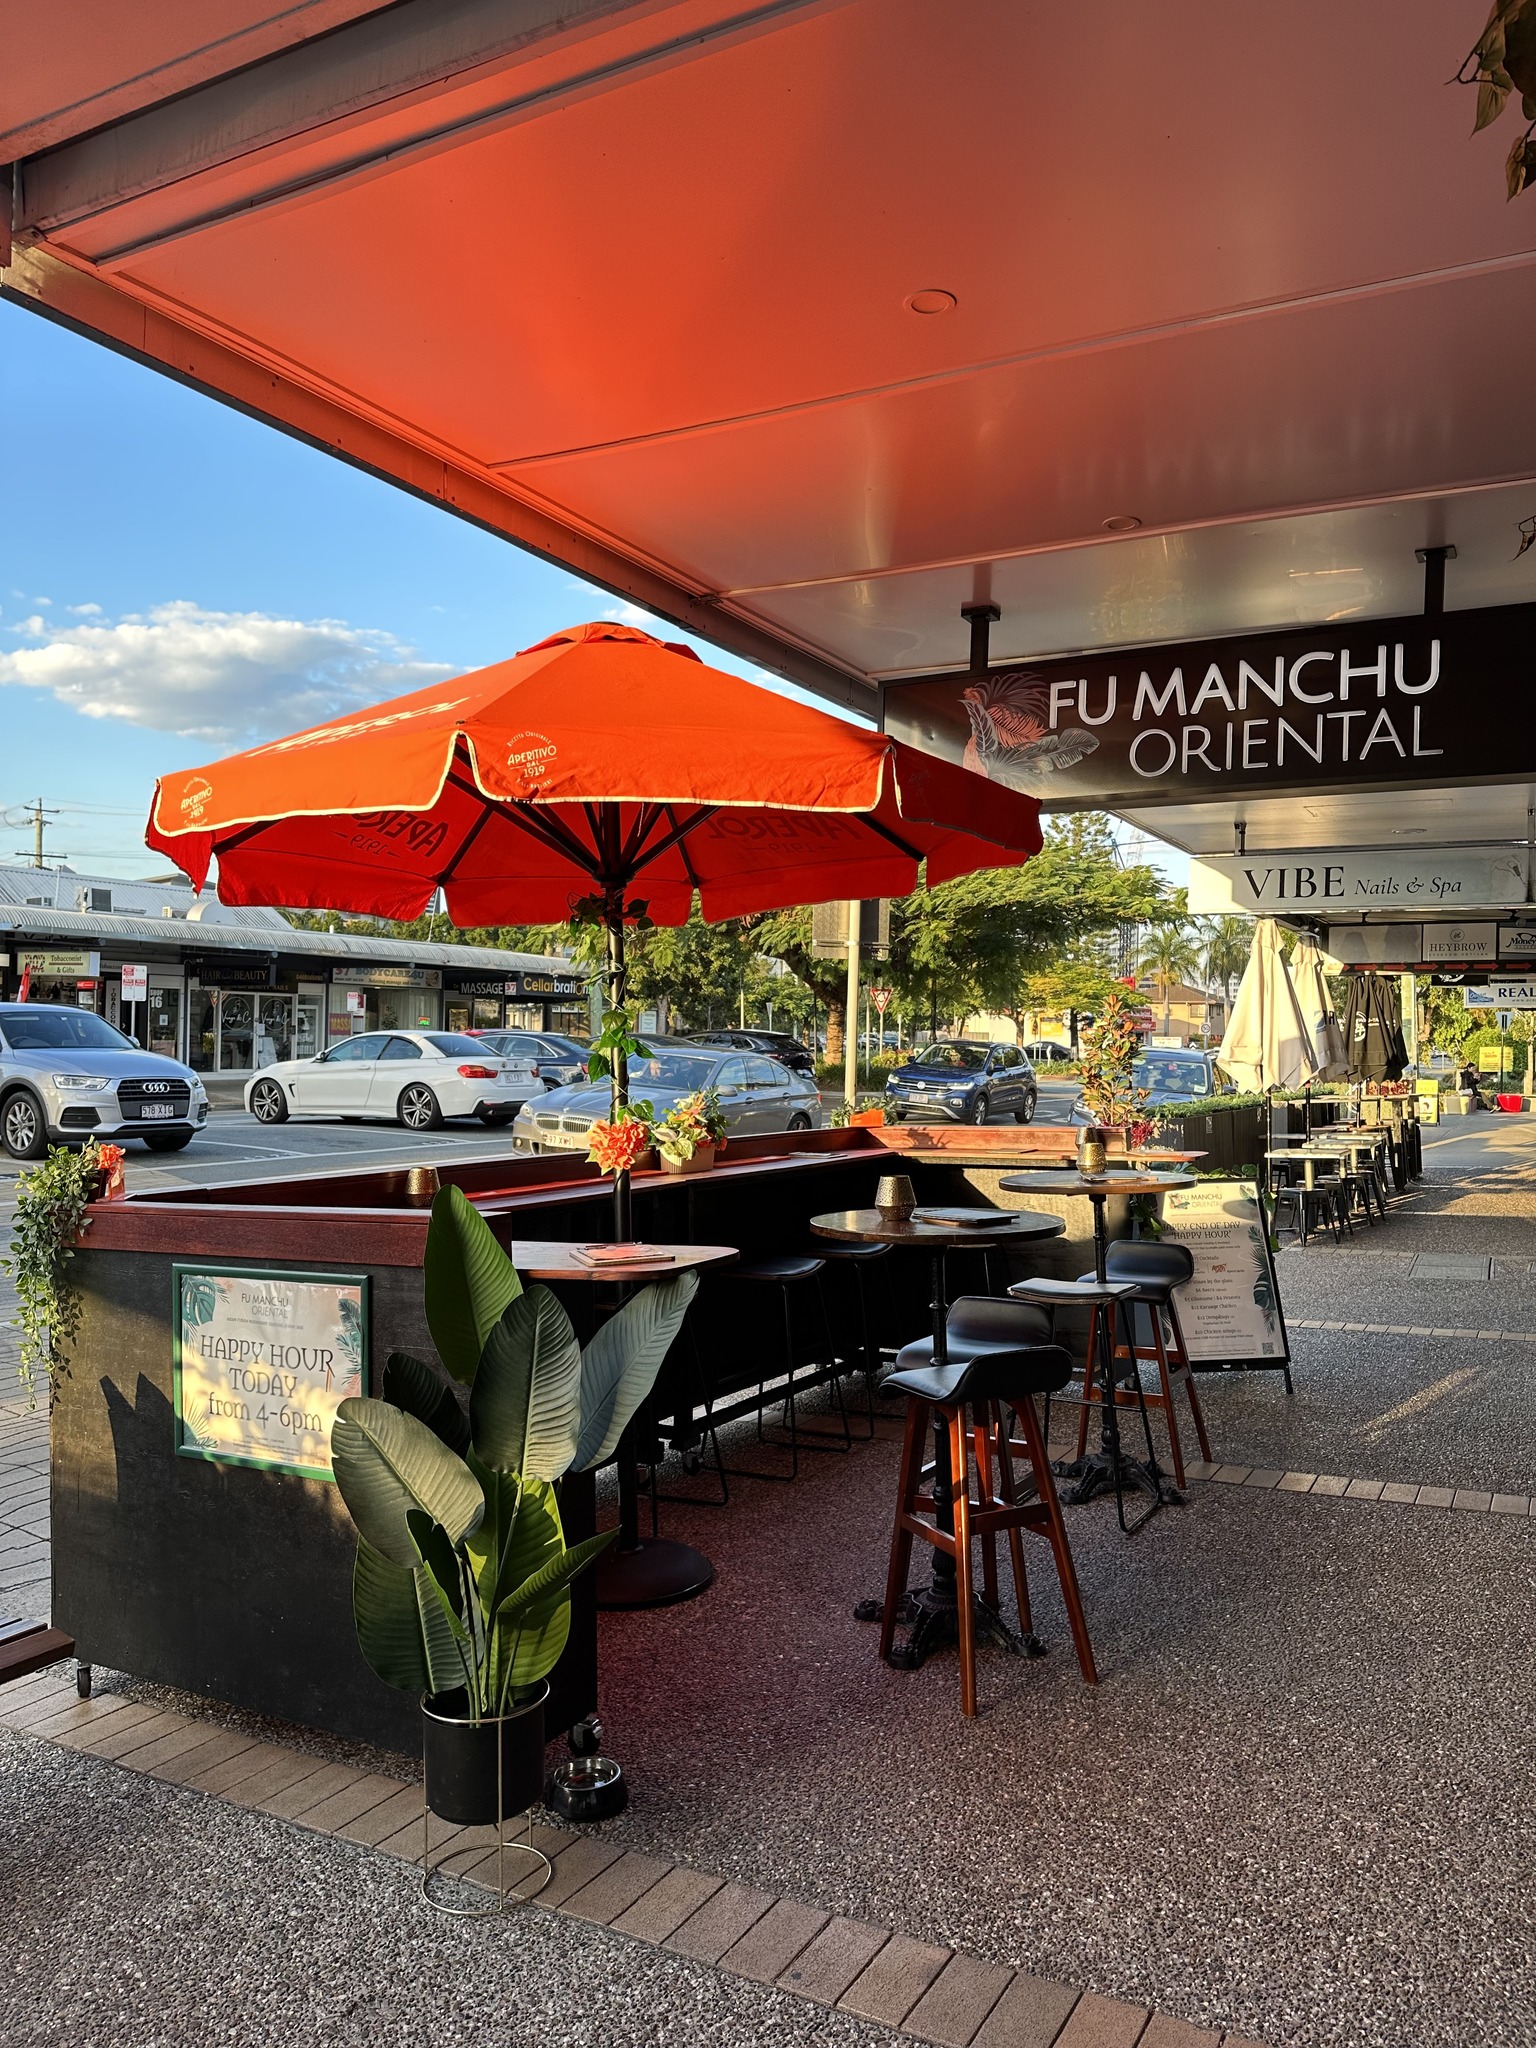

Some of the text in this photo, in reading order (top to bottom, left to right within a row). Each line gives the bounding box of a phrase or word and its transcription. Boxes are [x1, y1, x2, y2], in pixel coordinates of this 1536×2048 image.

[1048, 639, 1441, 730] FU MANCHU
[1129, 705, 1444, 778] ORIENTAL
[507, 745, 557, 766] APERITIVO
[524, 765, 546, 778] 1919
[180, 786, 213, 811] APERITIVO
[190, 805, 204, 819] 1919
[1243, 866, 1462, 899] VIBE Nails & Spa
[1430, 943, 1488, 952] HEYBROW
[201, 970, 268, 980] HAIR BEAUTY
[461, 983, 503, 994] MASSAGE
[505, 983, 516, 991] 37
[523, 977, 591, 995] Cellarbration
[150, 996, 163, 1009] 16
[142, 1105, 173, 1115] 578 XIG
[1190, 1222, 1208, 1230] END
[1210, 1221, 1221, 1230] OF
[1223, 1221, 1240, 1229] DAY
[241, 1293, 251, 1304] FU
[251, 1305, 288, 1319] ORIENTAL
[200, 1335, 335, 1378] HAPPY HOUR
[229, 1367, 298, 1398] TODAY
[208, 1391, 323, 1436] from 4-6pm
